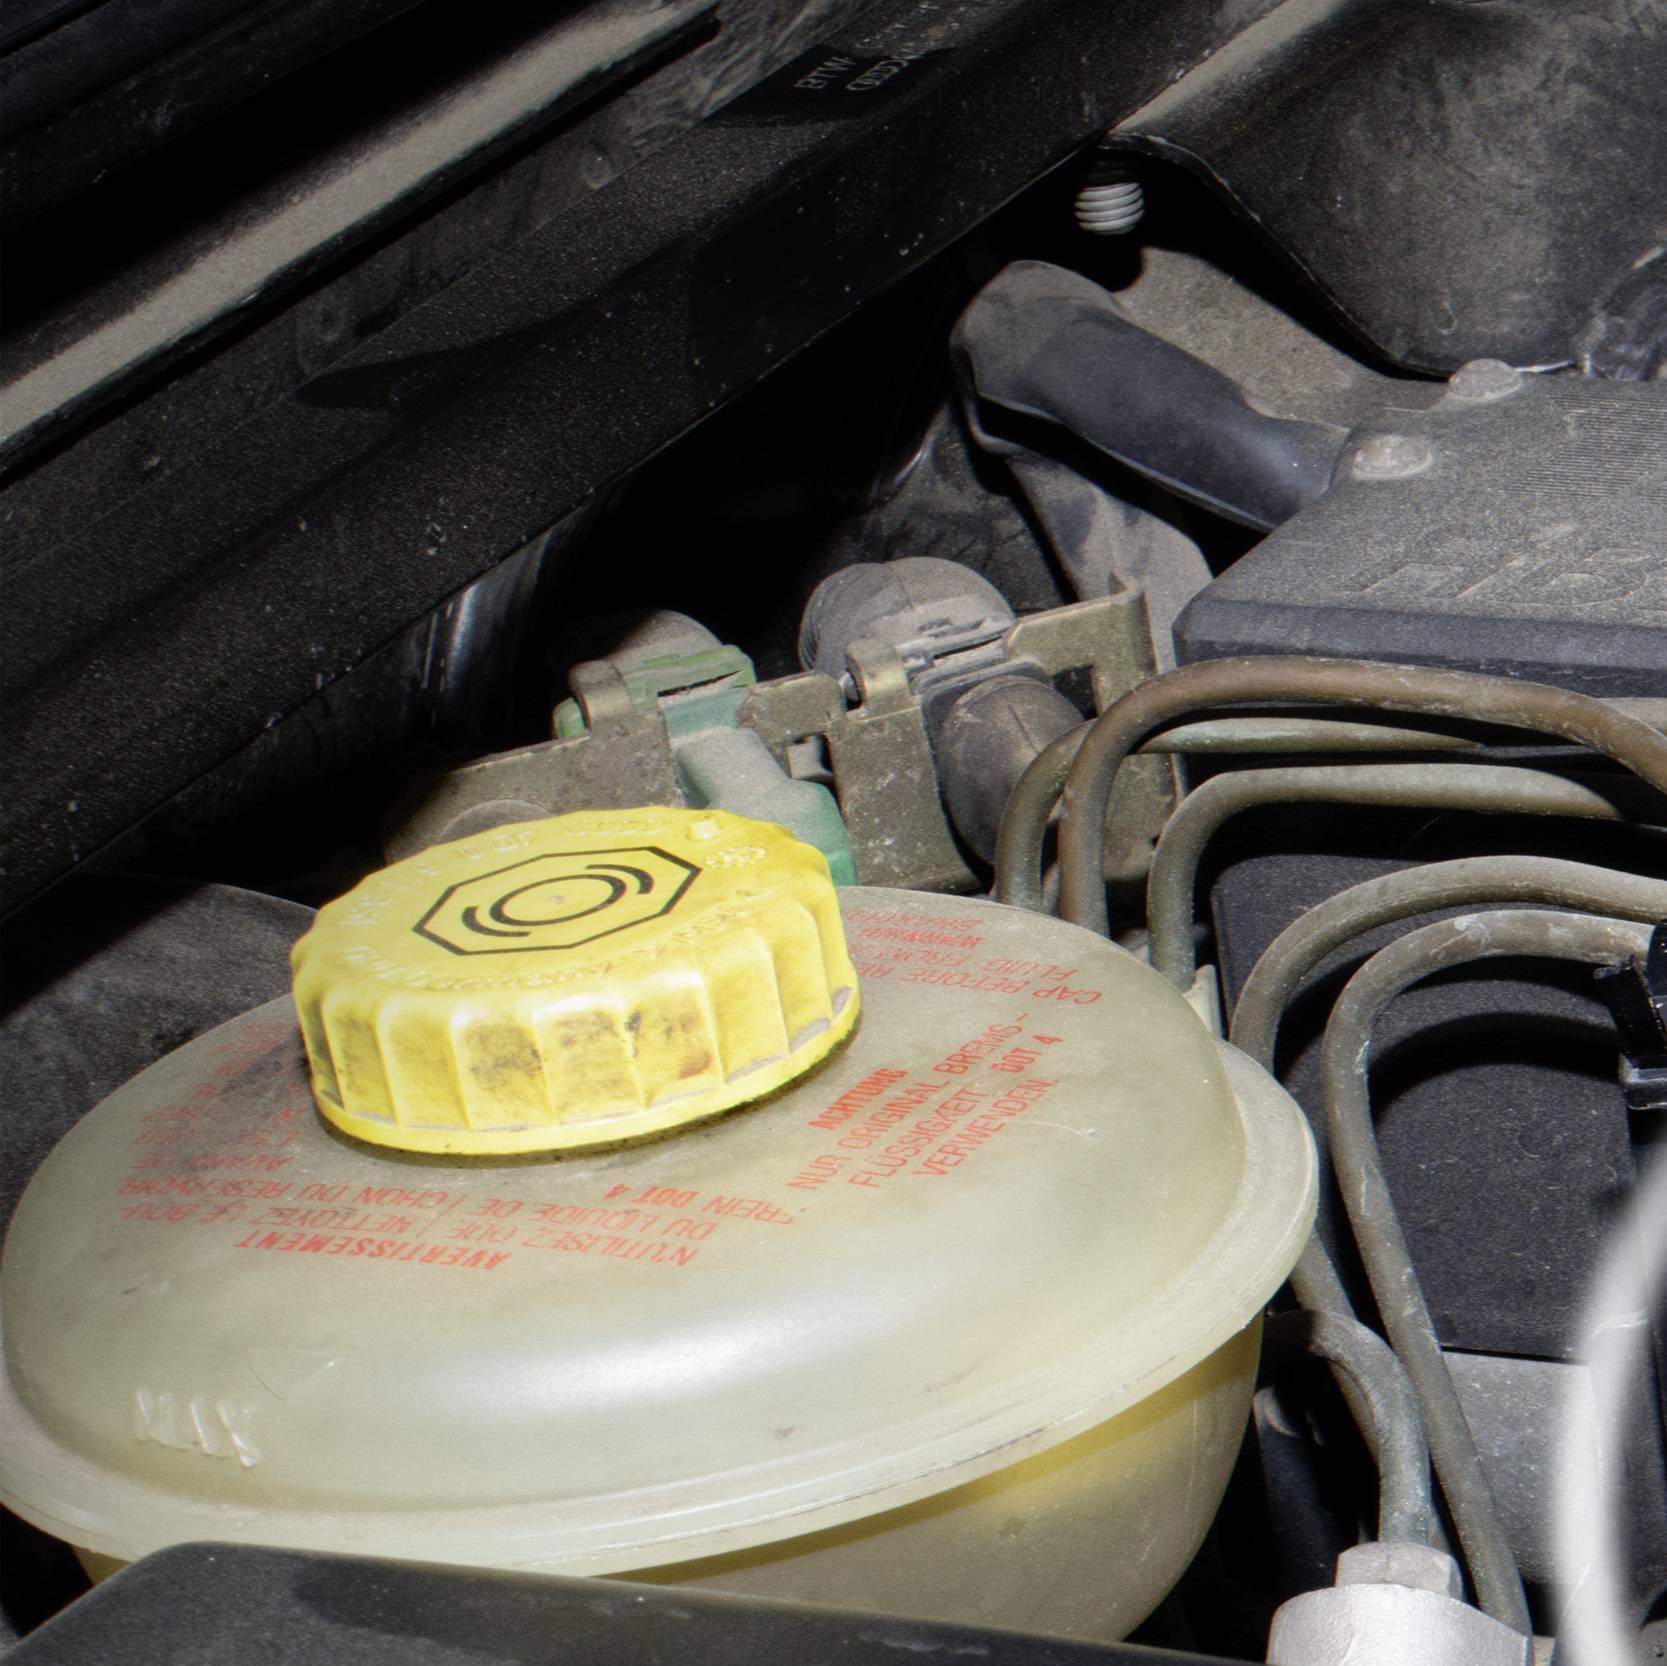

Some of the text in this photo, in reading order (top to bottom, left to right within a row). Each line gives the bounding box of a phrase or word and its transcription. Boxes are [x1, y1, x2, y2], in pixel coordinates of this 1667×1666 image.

[1032, 987, 1103, 1005] CAP
[990, 1046, 1044, 1074] DOT
[1031, 1032, 1064, 1046] 4
[808, 1067, 909, 1131] ACHTUNG
[786, 1153, 854, 1191] NUR
[837, 1080, 951, 1150] ORIGINAL
[298, 1182, 352, 1202] DU
[356, 1185, 450, 1210] CHON
[632, 1185, 700, 1208] DOT
[469, 1197, 525, 1219] DE
[660, 1218, 720, 1241] DU
[233, 1230, 513, 1270] AVERTISSEMENT
[521, 1227, 701, 1267] N'UTILISEZ
